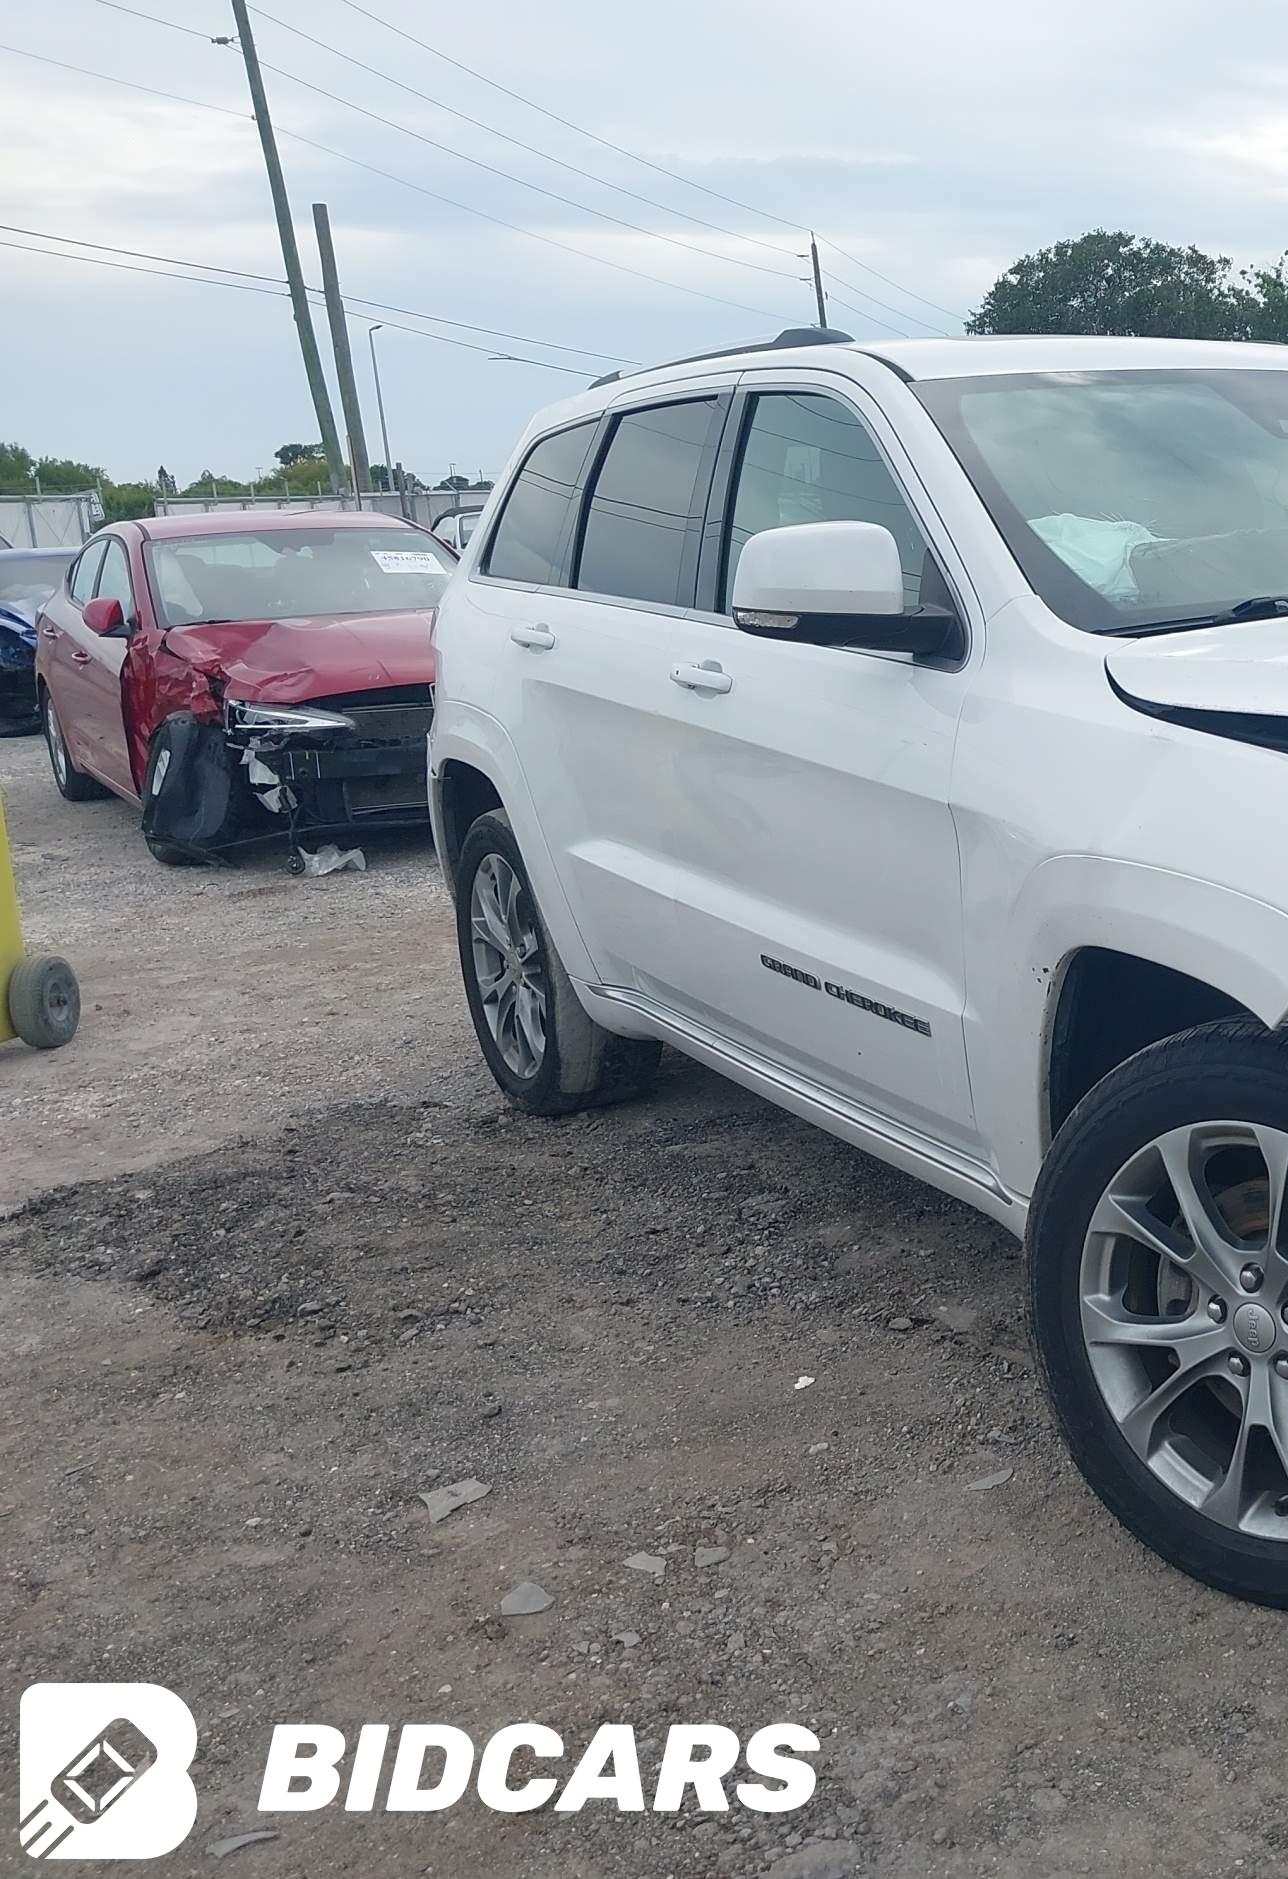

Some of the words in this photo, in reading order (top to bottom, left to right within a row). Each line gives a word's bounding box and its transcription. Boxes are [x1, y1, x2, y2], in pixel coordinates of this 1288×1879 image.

[760, 953, 821, 991] GRAND
[824, 980, 932, 1038] CHEROKEE
[1247, 1308, 1260, 1347] Jeep
